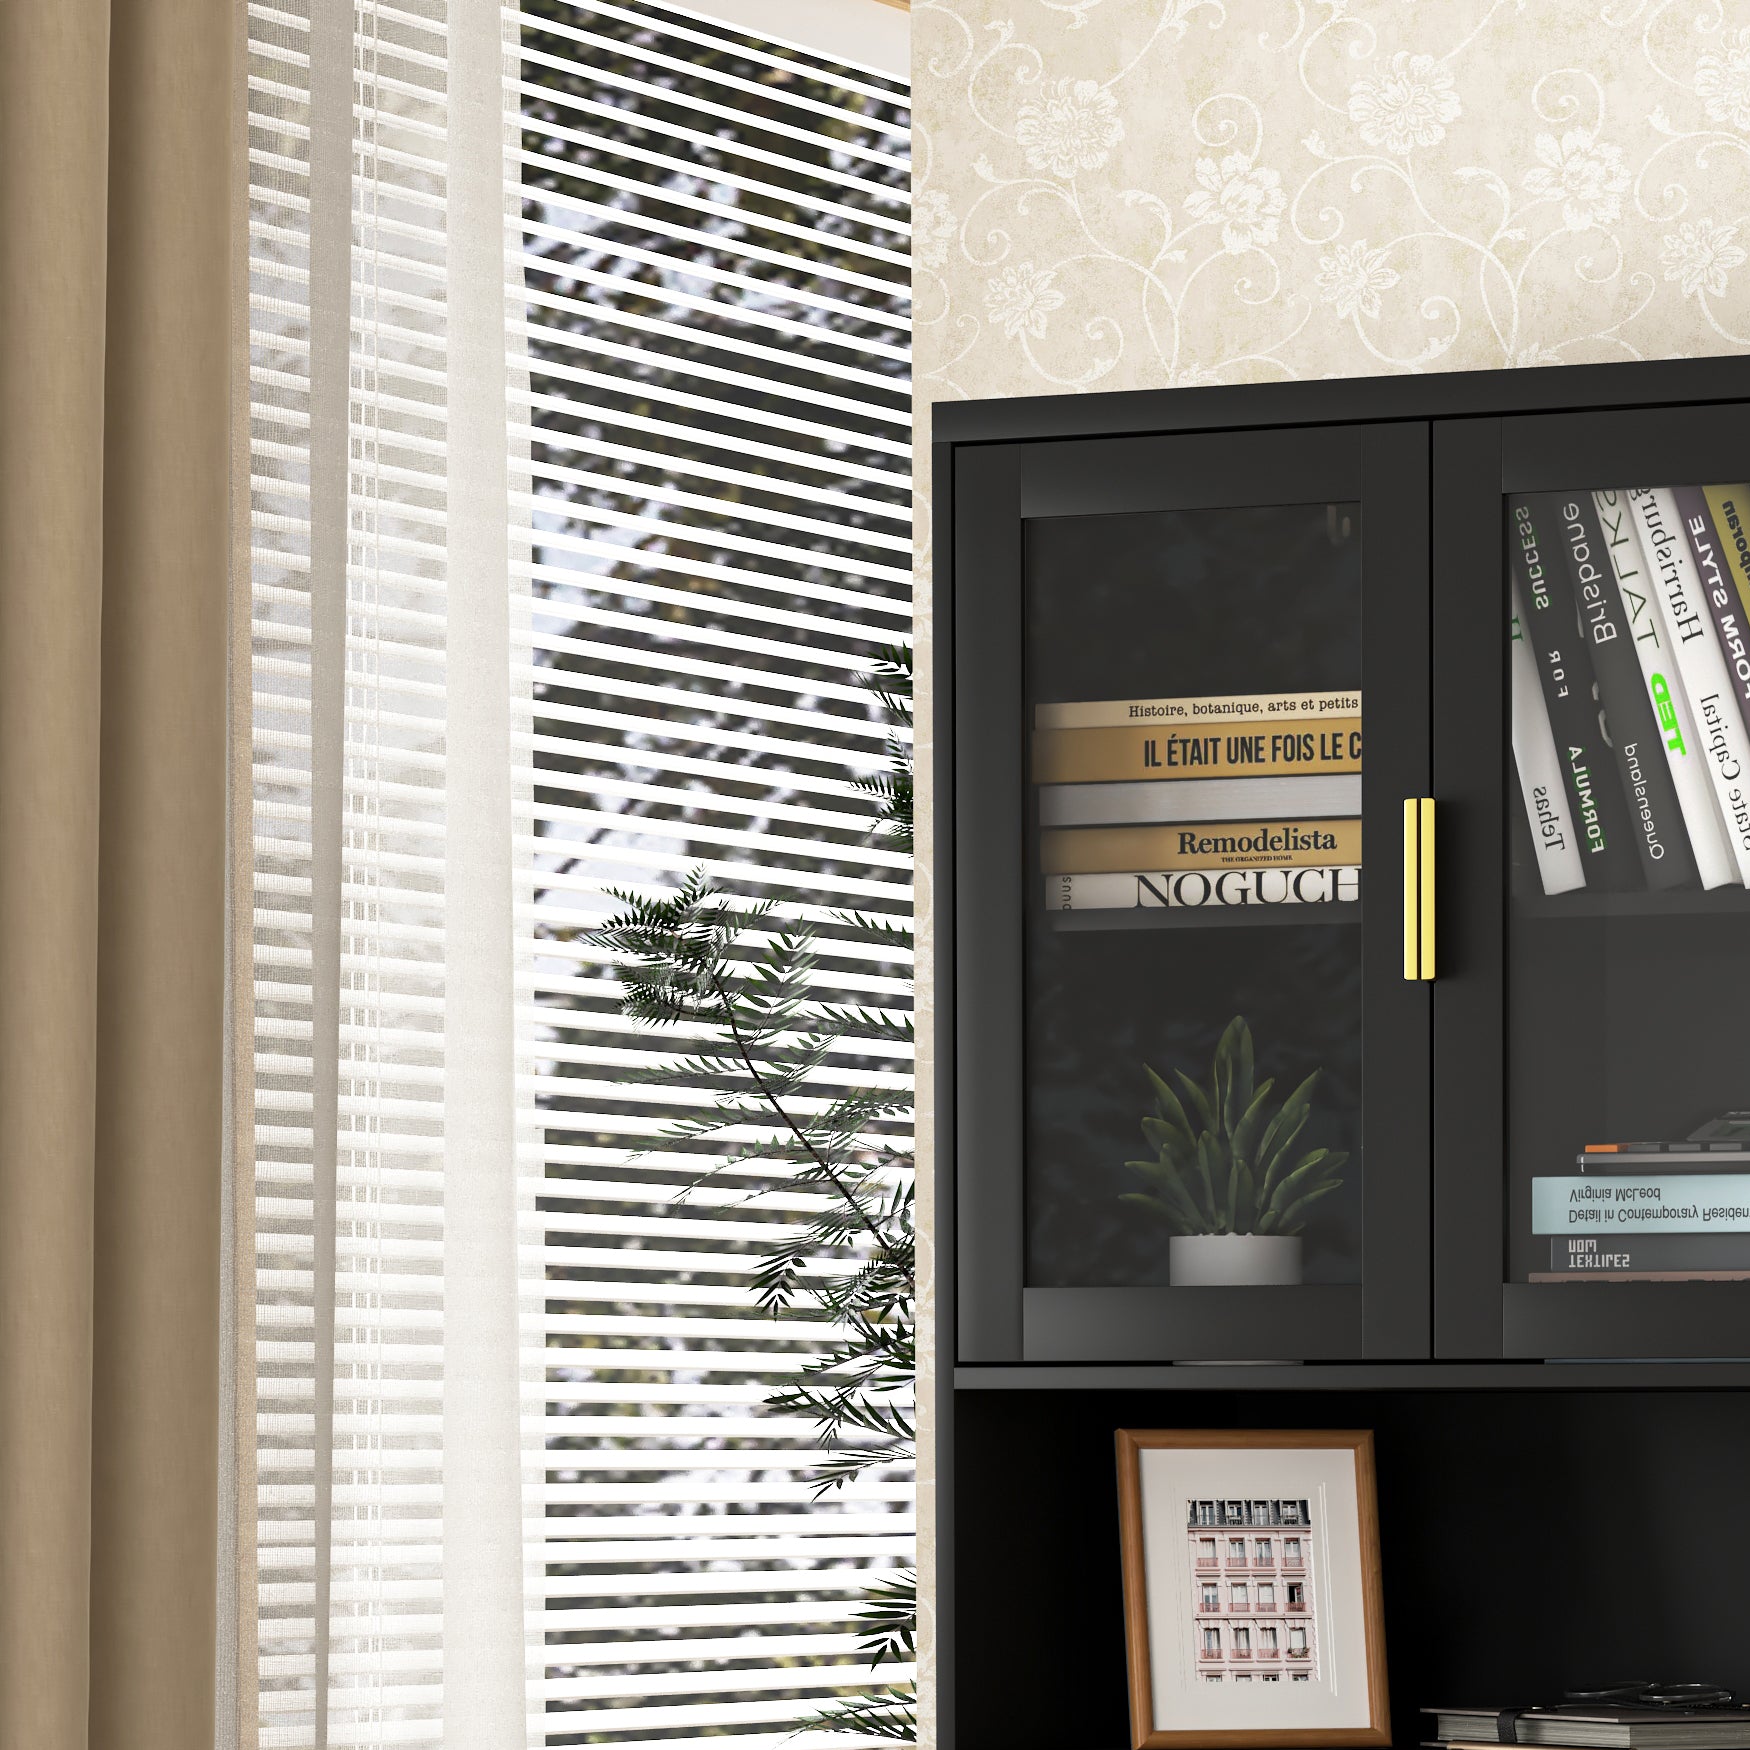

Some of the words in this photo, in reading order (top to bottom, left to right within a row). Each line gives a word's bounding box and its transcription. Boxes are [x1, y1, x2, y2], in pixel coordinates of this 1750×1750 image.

[1129, 705, 1188, 717] Histoire,
[1192, 702, 1263, 716] botanique,
[1268, 700, 1296, 712] arts
[1301, 699, 1314, 710] et
[1319, 697, 1359, 712] petits
[1144, 740, 1162, 767] IL
[1167, 734, 1221, 766] ÉTAIT
[1226, 735, 1266, 764] UNE
[1271, 733, 1315, 762] FOIS
[1320, 732, 1343, 760] LE
[1177, 828, 1337, 855] Remodelista
